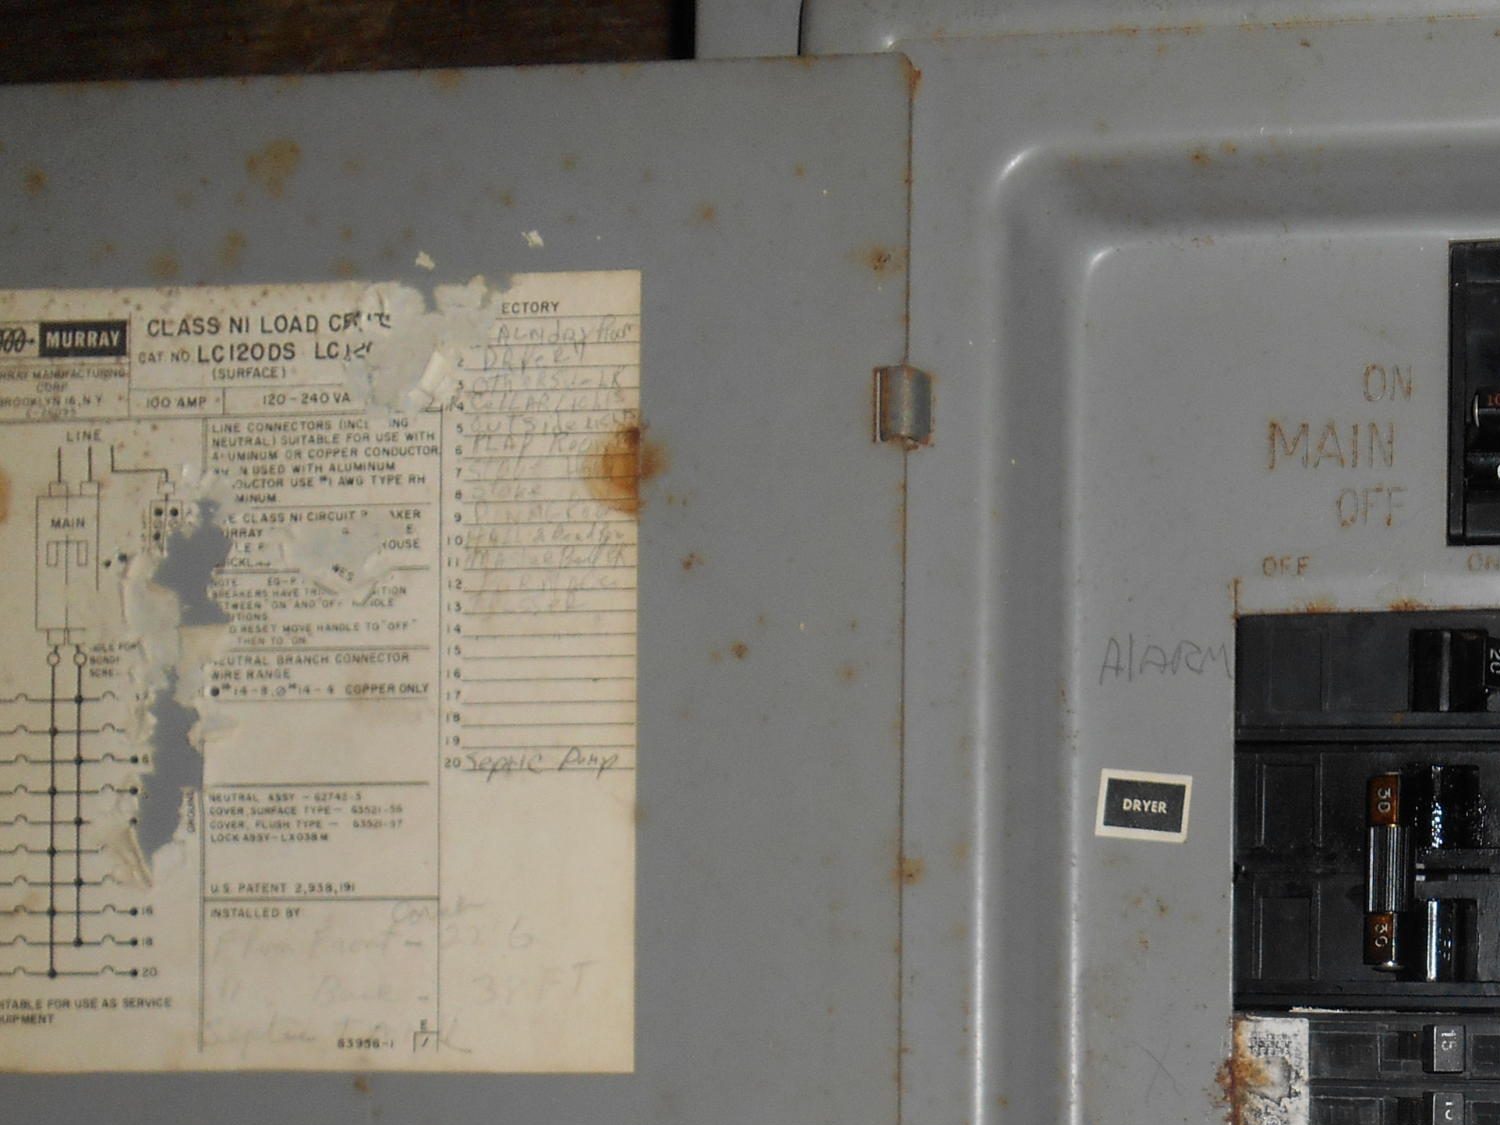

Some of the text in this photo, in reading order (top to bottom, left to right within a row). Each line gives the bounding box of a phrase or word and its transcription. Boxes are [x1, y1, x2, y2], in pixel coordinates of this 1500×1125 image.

[148, 316, 220, 337] CLASS
[261, 314, 318, 334] LOAD
[46, 330, 120, 348] MURRAY
[198, 342, 295, 364] LC120DS
[212, 367, 286, 381] (SURFACE)
[1363, 363, 1413, 403] ON
[212, 421, 331, 433] LINE CONNECTORS
[66, 431, 101, 442] LINE
[281, 434, 339, 446] SUITABLE
[346, 432, 370, 442] FOR
[376, 432, 399, 442] USE
[405, 431, 435, 441] WITH
[1268, 420, 1395, 469] MAIN
[308, 447, 358, 459] COPPER
[252, 462, 395, 475] USED WITH ALUMINUM
[290, 477, 313, 487] USE
[371, 474, 402, 485] TYPE
[1336, 486, 1406, 528] OFF
[243, 512, 285, 523] CLASS
[307, 510, 356, 521] CIRCUIT
[51, 518, 85, 529] MAIN
[447, 535, 463, 546] 10
[1262, 555, 1310, 578] OFF
[447, 578, 463, 590] 12
[447, 601, 462, 612] 13
[446, 624, 462, 634] 14
[446, 645, 461, 655] 15
[335, 652, 409, 664] CONNECTOR
[446, 666, 461, 679] 16
[345, 683, 429, 696] COPPER ONLY
[446, 690, 461, 700] 17
[446, 712, 461, 722] 18
[445, 735, 460, 746] 19
[444, 757, 461, 768] 20
[1122, 797, 1168, 815] DRYER
[1376, 787, 1392, 815] 30
[211, 907, 279, 918] INSTALLED
